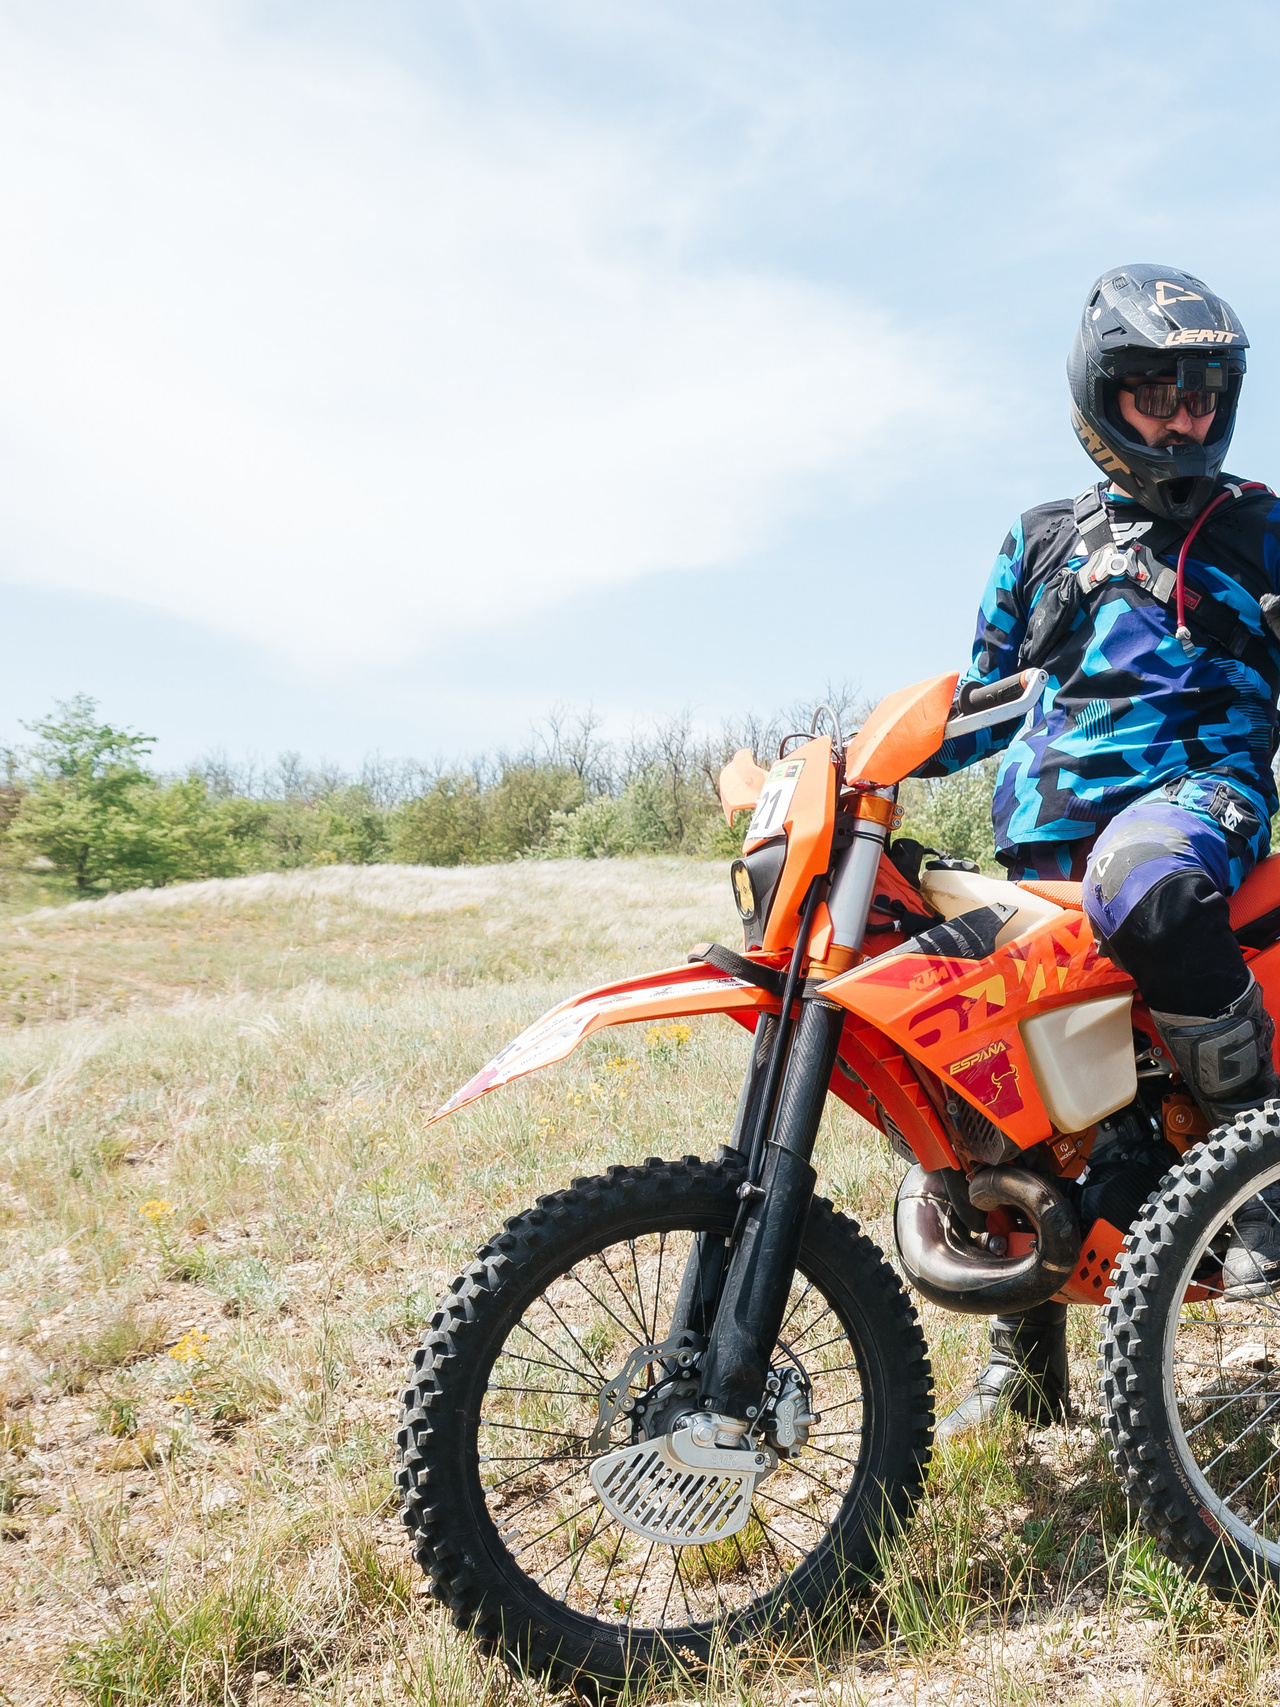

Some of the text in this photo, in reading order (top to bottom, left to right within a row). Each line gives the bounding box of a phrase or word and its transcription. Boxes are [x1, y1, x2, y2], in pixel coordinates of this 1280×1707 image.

[1164, 328, 1239, 346] LEATT
[908, 965, 949, 991] KTM
[950, 1041, 1007, 1076] ESPAÑA
[1198, 1020, 1258, 1094] G
[1164, 1435, 1200, 1507] WASHOUGAL
